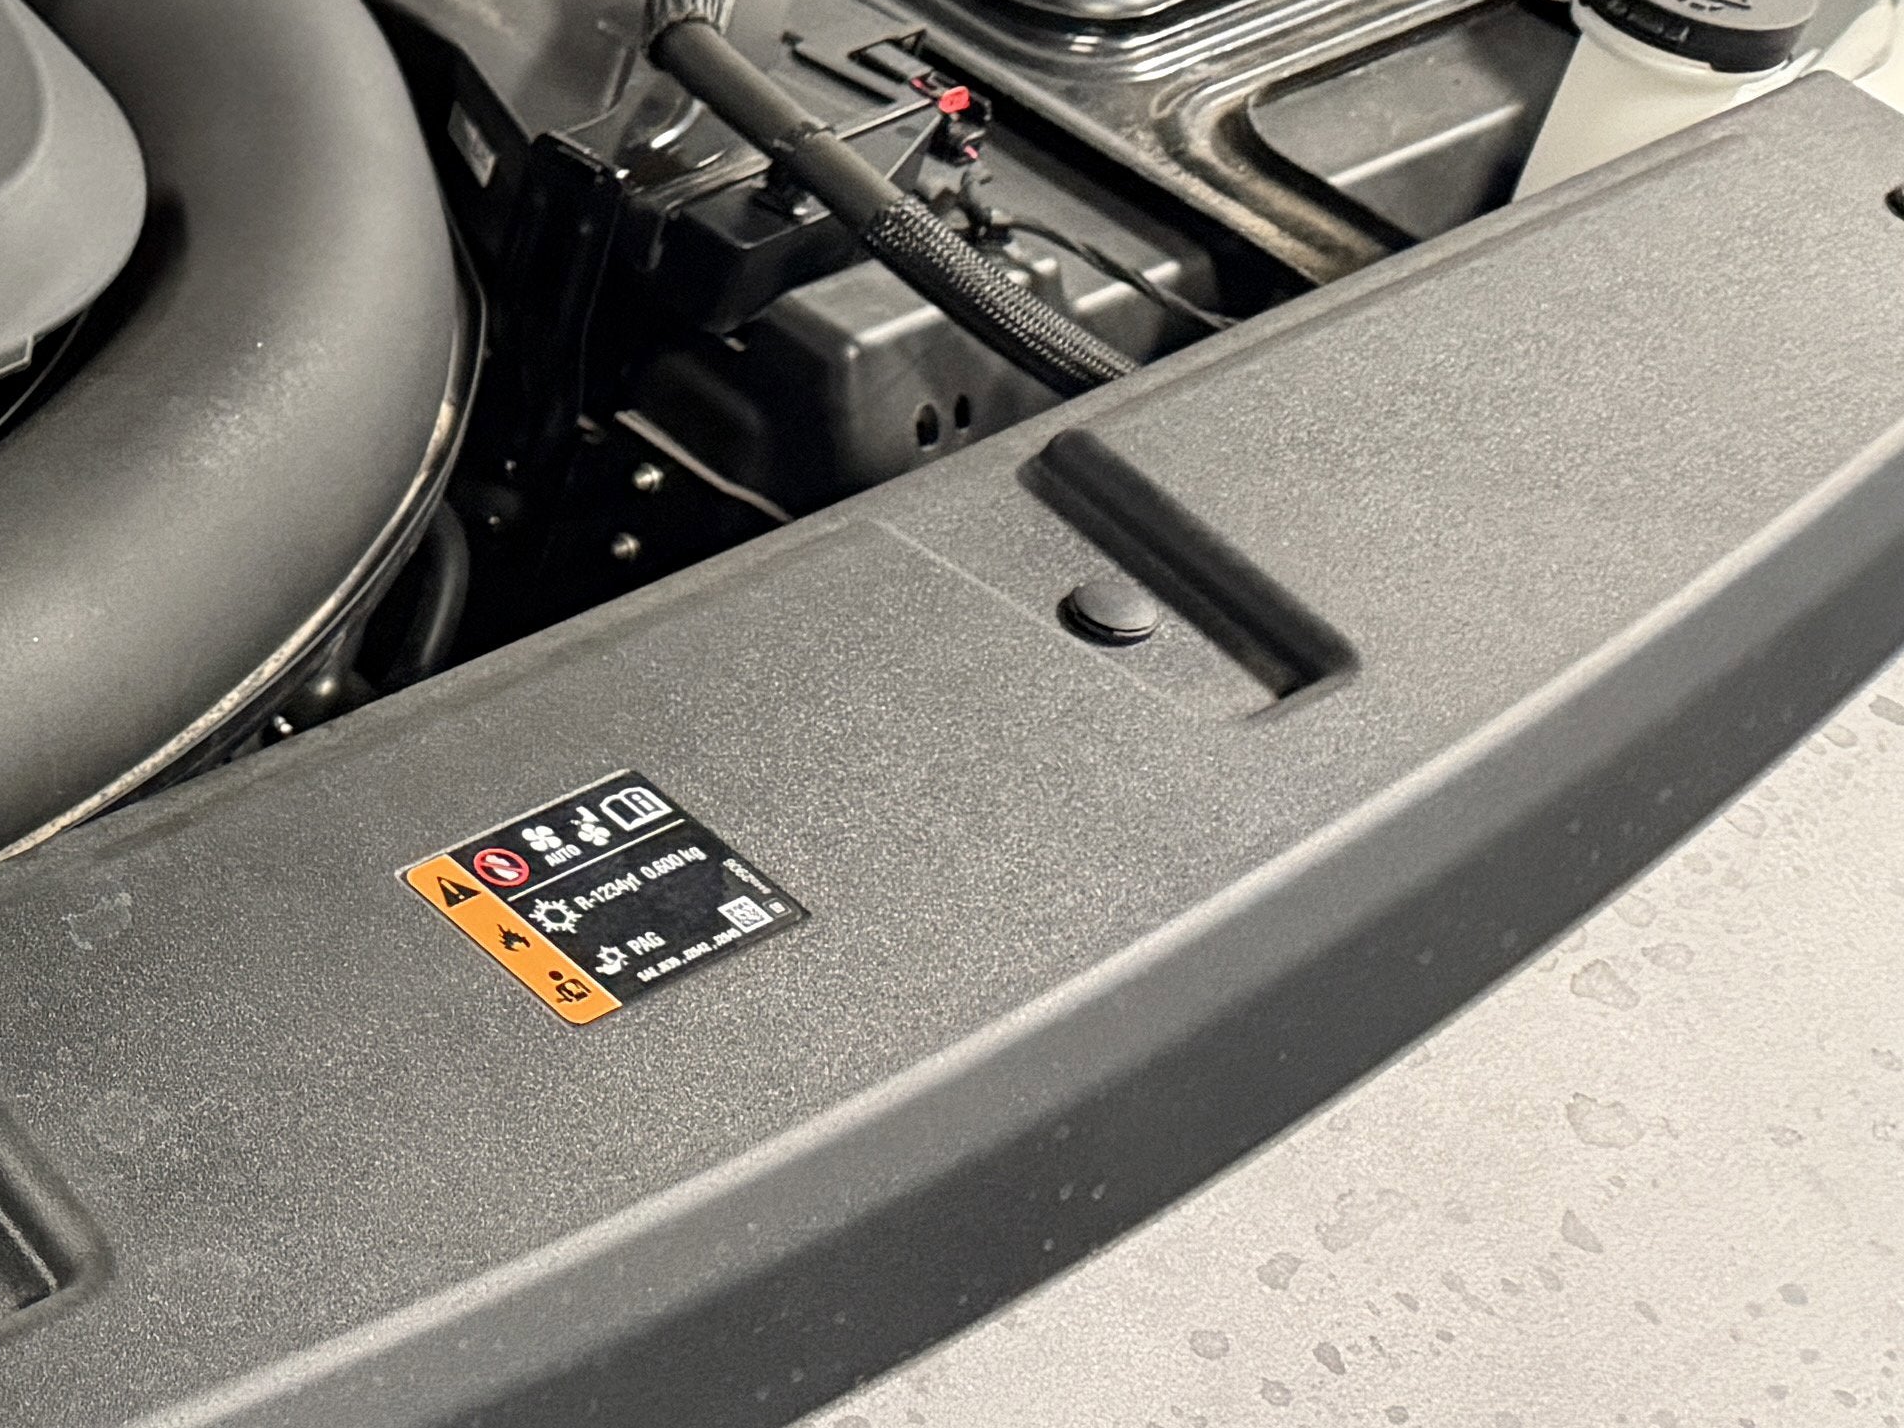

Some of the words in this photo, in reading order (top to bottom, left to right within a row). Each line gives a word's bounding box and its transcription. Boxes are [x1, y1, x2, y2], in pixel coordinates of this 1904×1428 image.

[544, 843, 583, 868] AUTO
[573, 872, 642, 911] R-1234yf
[640, 852, 684, 880] 0.600
[677, 846, 708, 862] kg
[626, 931, 667, 956] PAG
